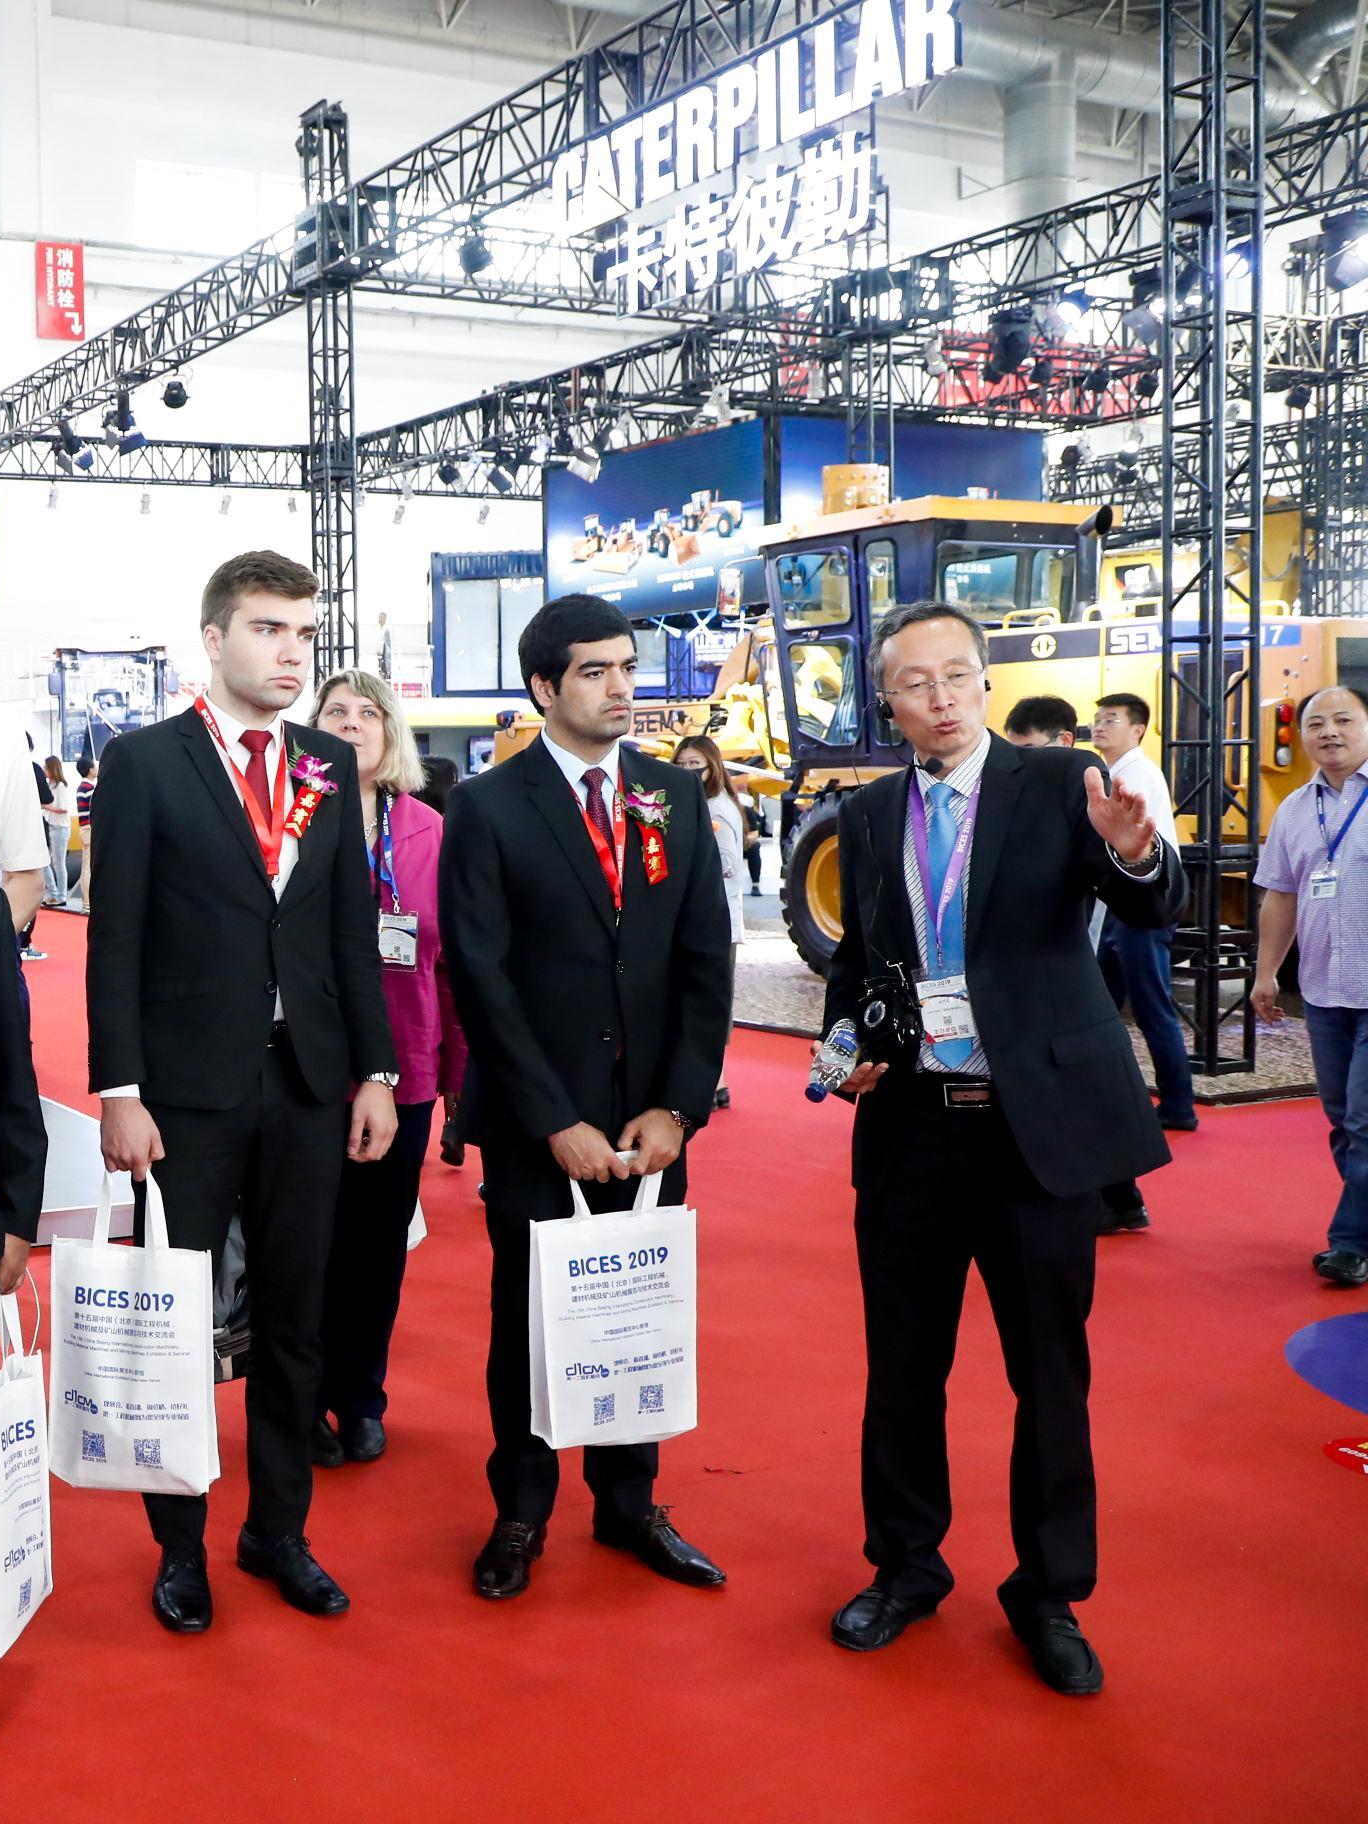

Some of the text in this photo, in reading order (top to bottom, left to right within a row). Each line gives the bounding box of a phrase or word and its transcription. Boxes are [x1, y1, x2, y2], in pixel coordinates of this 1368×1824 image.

[552, 0, 960, 236] CATERPILLAR
[607, 130, 874, 297] 卡特彼勒
[56, 248, 75, 308] 消防栓
[956, 818, 973, 853] BICES 2019
[944, 877, 955, 896] 2019
[568, 1246, 669, 1278] BICES 2019
[74, 1286, 175, 1312] BICES 2019
[0, 1419, 36, 1452] BICES
